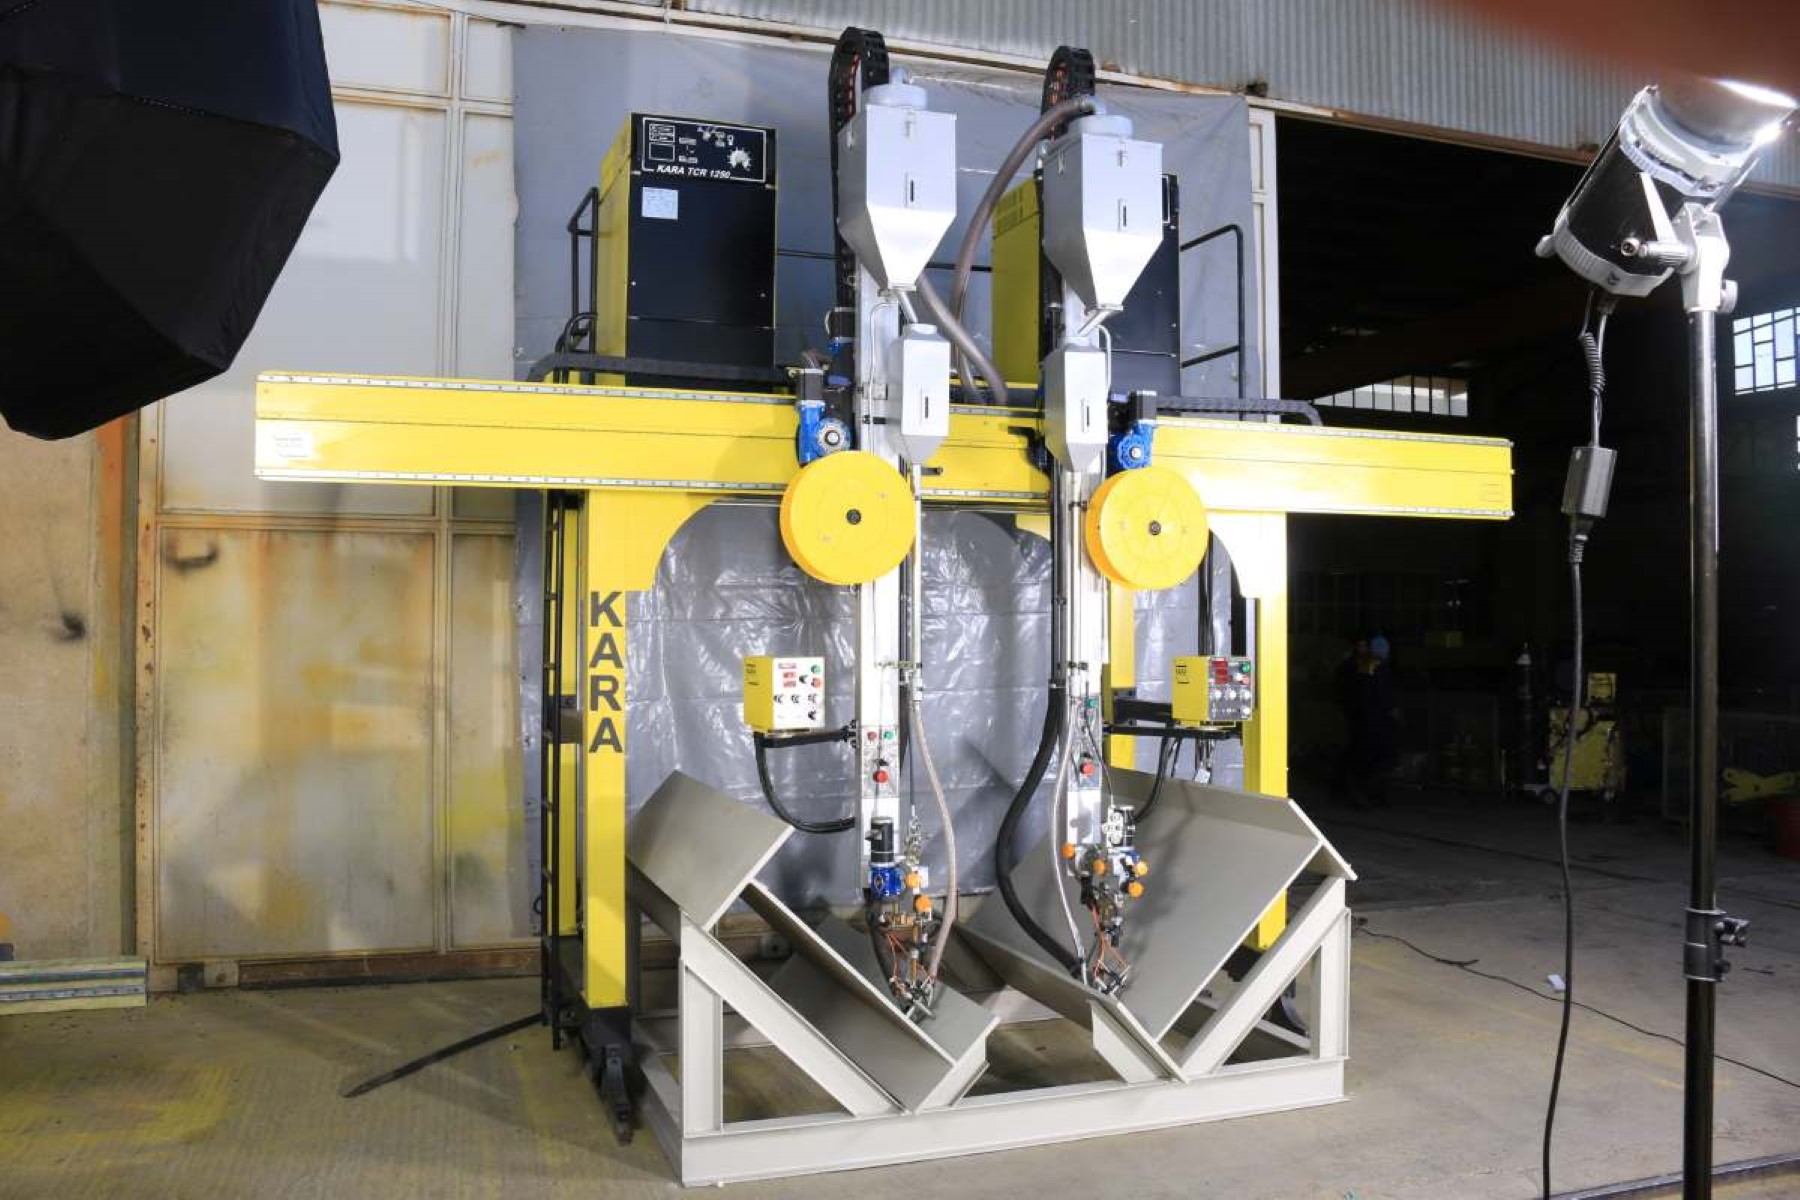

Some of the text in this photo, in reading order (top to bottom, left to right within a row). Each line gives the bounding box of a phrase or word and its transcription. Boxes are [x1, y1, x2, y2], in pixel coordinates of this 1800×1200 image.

[657, 164, 685, 175] KARA
[687, 167, 708, 177] TCR
[589, 591, 624, 753] KARA
